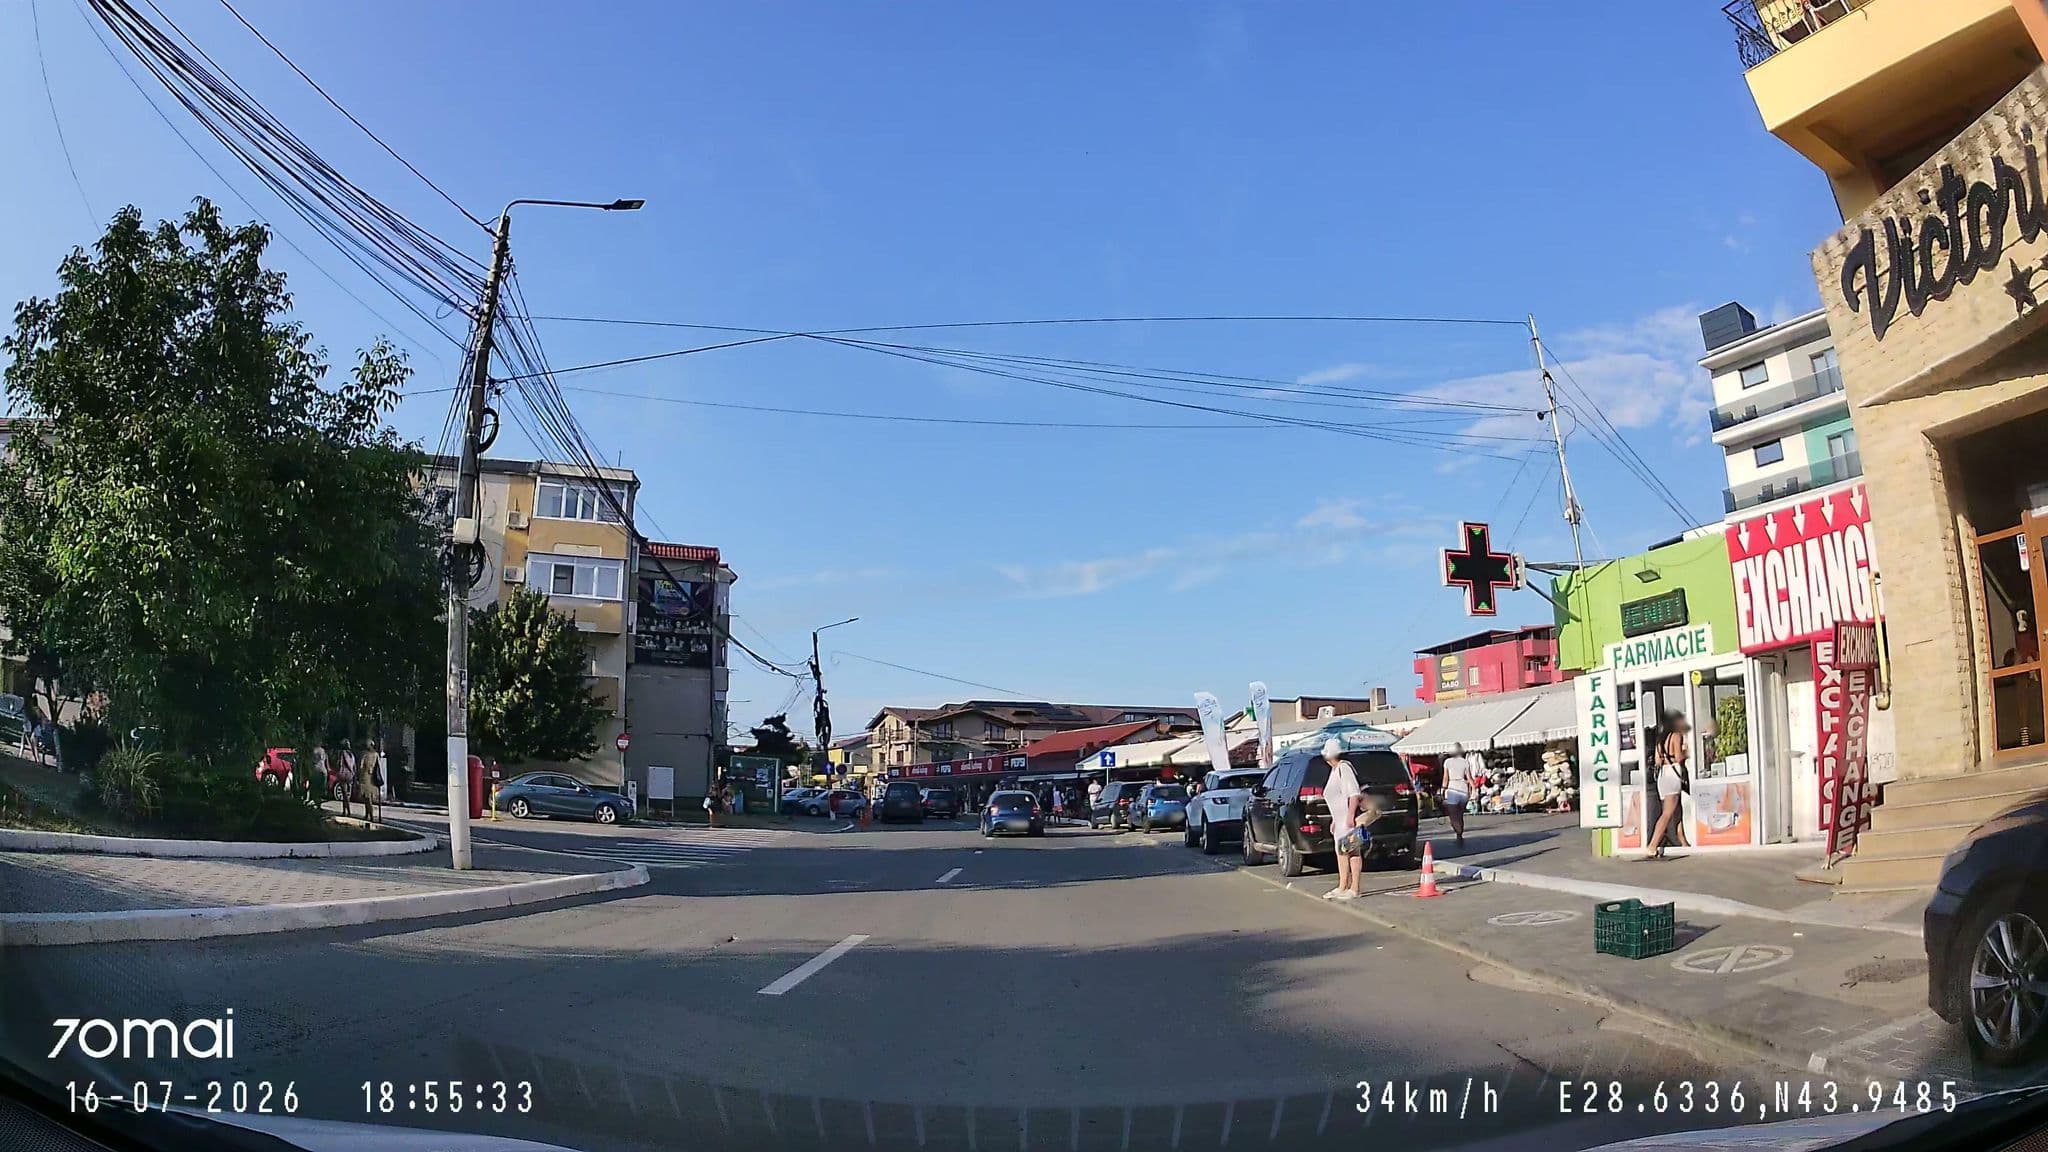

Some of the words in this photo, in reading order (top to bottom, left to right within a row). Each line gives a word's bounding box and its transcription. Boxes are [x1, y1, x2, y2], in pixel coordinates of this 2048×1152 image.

[1841, 122, 2048, 342] Victori
[1613, 628, 1706, 669] FARMACIE
[1590, 676, 1608, 819] FARMACIE
[1836, 671, 1865, 849] EXCHANGE
